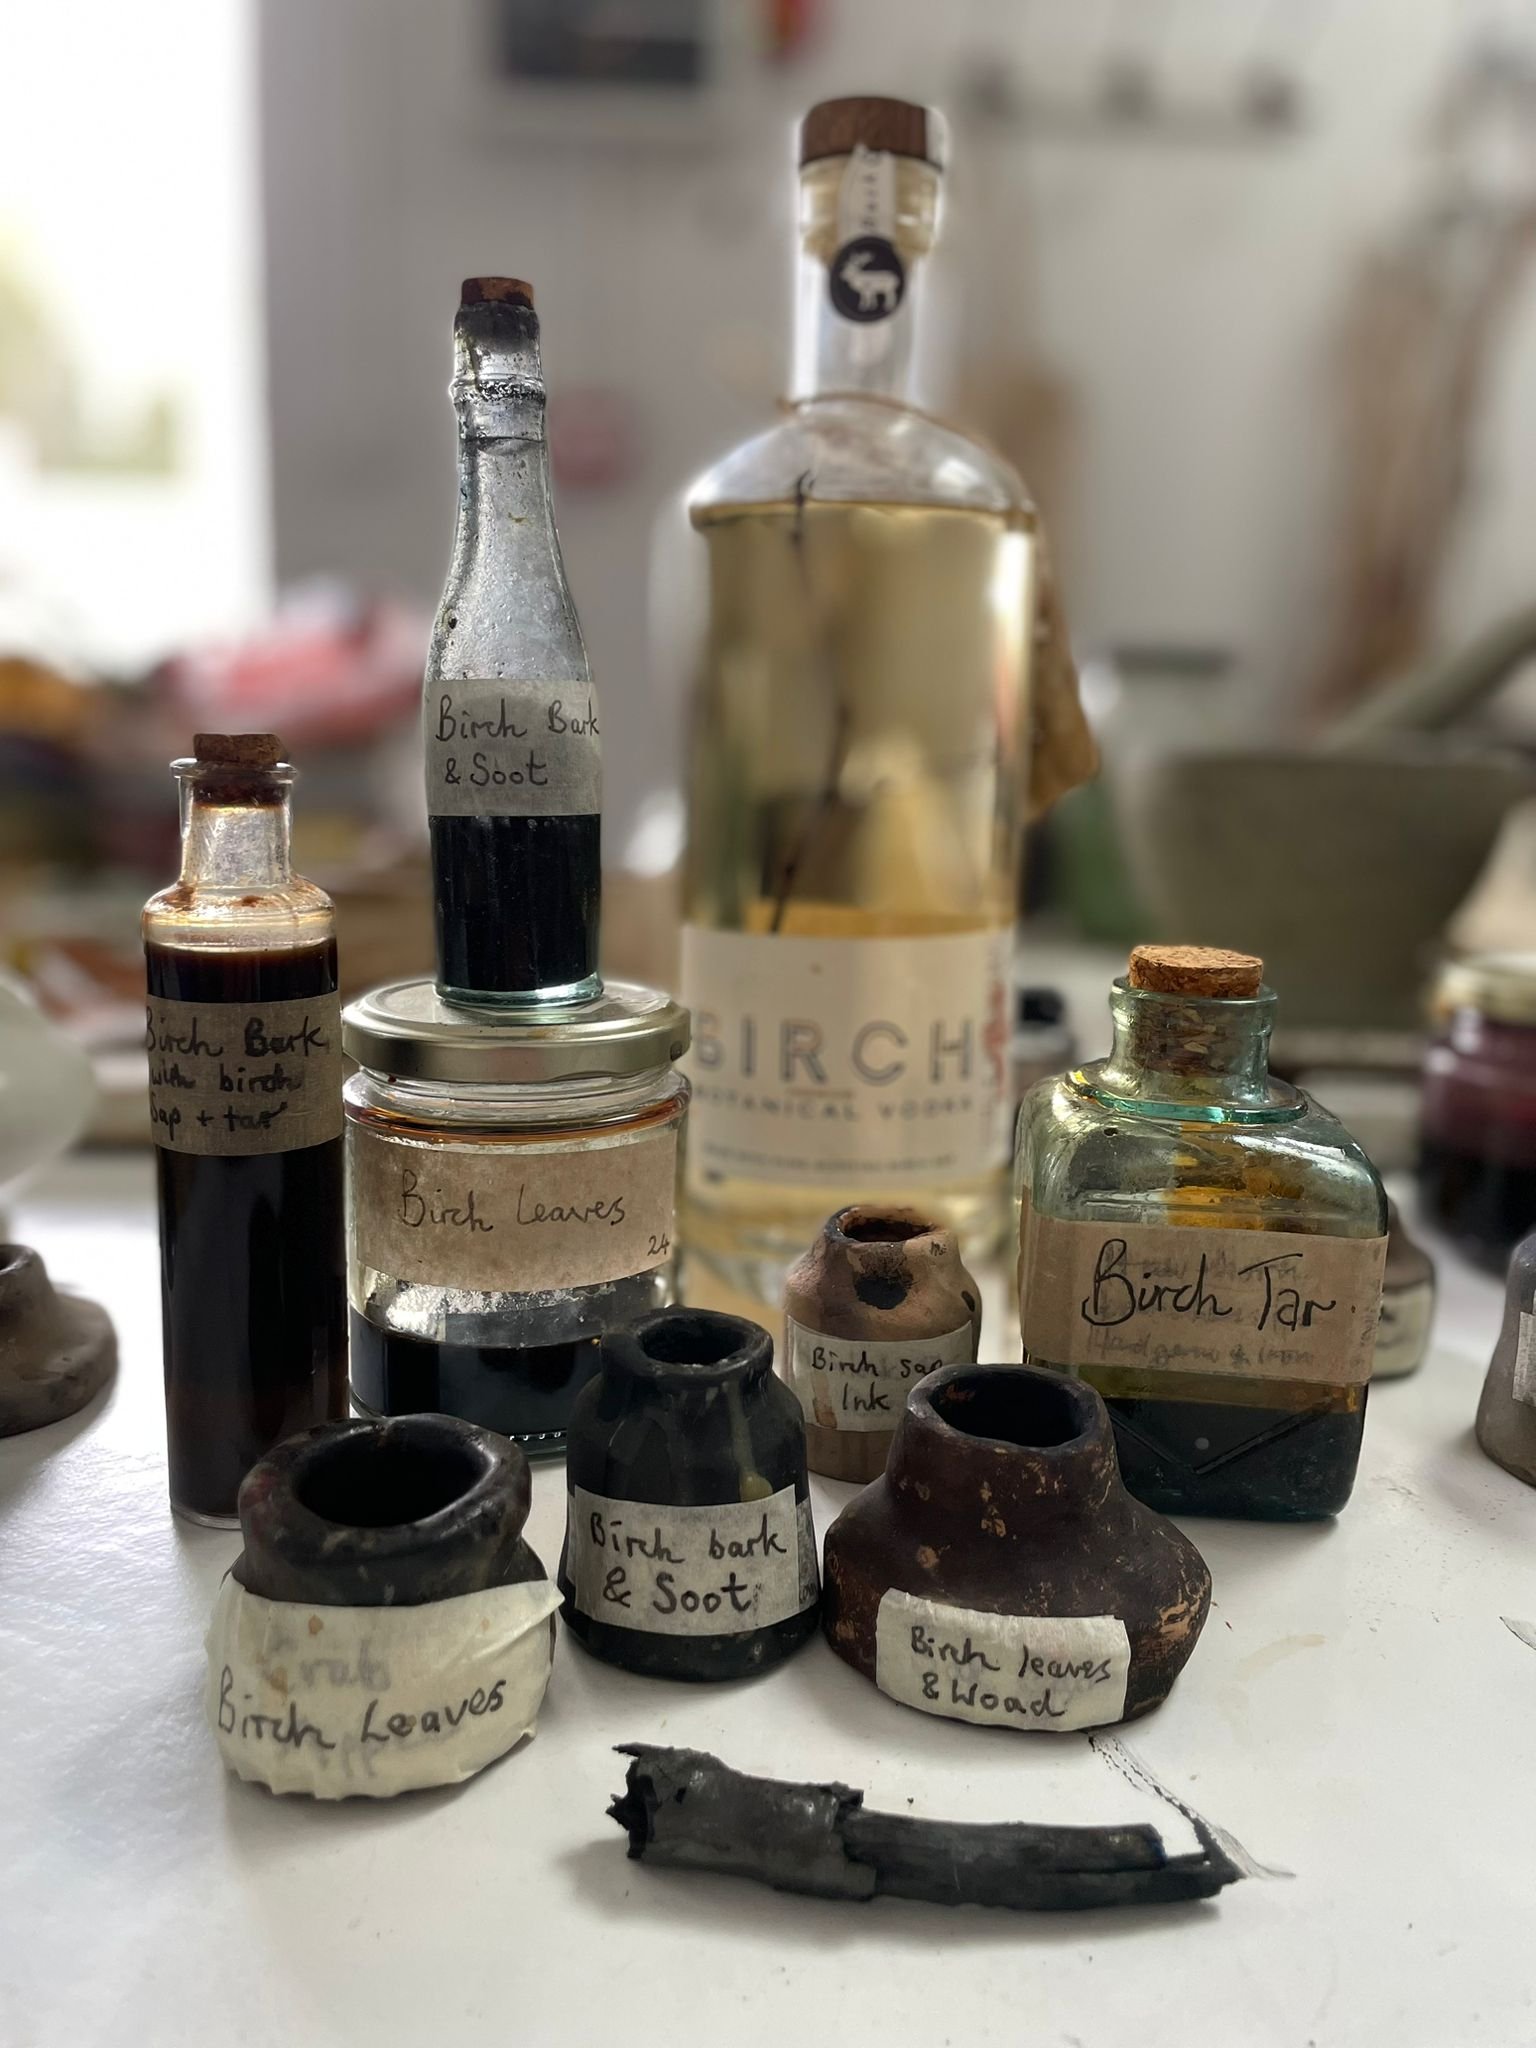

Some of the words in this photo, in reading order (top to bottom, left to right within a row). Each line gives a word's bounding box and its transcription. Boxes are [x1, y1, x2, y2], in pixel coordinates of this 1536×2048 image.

[435, 694, 528, 742] Birch
[548, 700, 600, 737] Bark
[444, 757, 461, 785] &
[470, 750, 549, 786] Soot
[146, 1005, 224, 1057] Birch
[245, 1015, 325, 1057] Bark
[694, 1010, 976, 1086] BIRCH
[197, 1109, 214, 1127] +
[400, 1169, 494, 1232] Birch
[647, 1233, 670, 1256] 24
[1081, 1238, 1233, 1327] Birch
[1237, 1253, 1337, 1332] Tar
[811, 1347, 879, 1377] Birch
[842, 1381, 890, 1411] Ink
[590, 1512, 686, 1563] Birch
[708, 1513, 787, 1559] bark
[602, 1566, 631, 1608] &
[652, 1572, 752, 1615] Soot
[911, 1625, 1001, 1671] Birch
[217, 1664, 336, 1750] Birch
[361, 1679, 506, 1744] Leaves
[922, 1672, 940, 1700] &
[951, 1679, 1066, 1717] Woad
